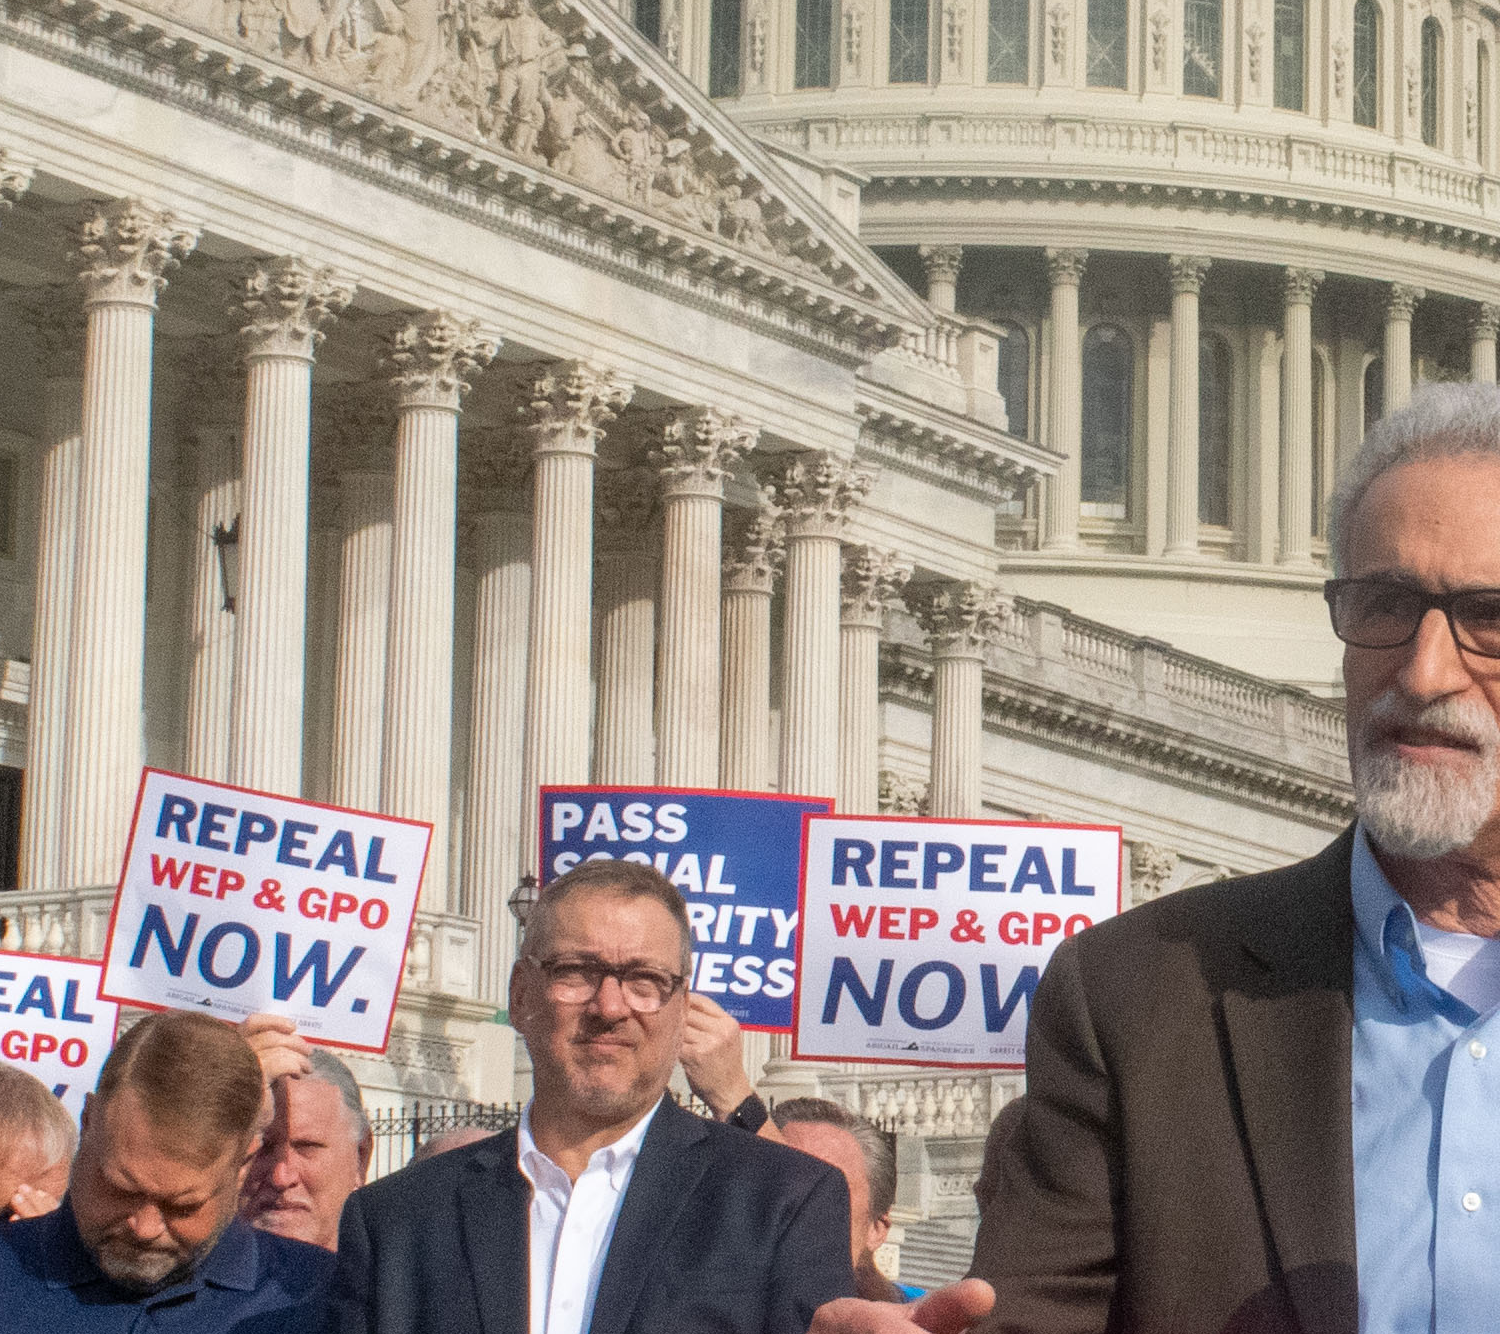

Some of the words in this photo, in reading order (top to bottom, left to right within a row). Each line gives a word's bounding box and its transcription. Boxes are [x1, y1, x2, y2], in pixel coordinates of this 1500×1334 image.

[155, 793, 397, 884] REPEAL
[552, 802, 688, 843] PASS
[150, 853, 246, 900] WEP
[253, 878, 285, 912] &
[298, 887, 389, 930] GPO
[831, 838, 1096, 897] REPEAL
[830, 904, 940, 941] WEP
[950, 909, 986, 944] &
[998, 911, 1094, 946] GPO
[129, 903, 370, 1014] NOW.
[1, 1030, 89, 1067] GPO
